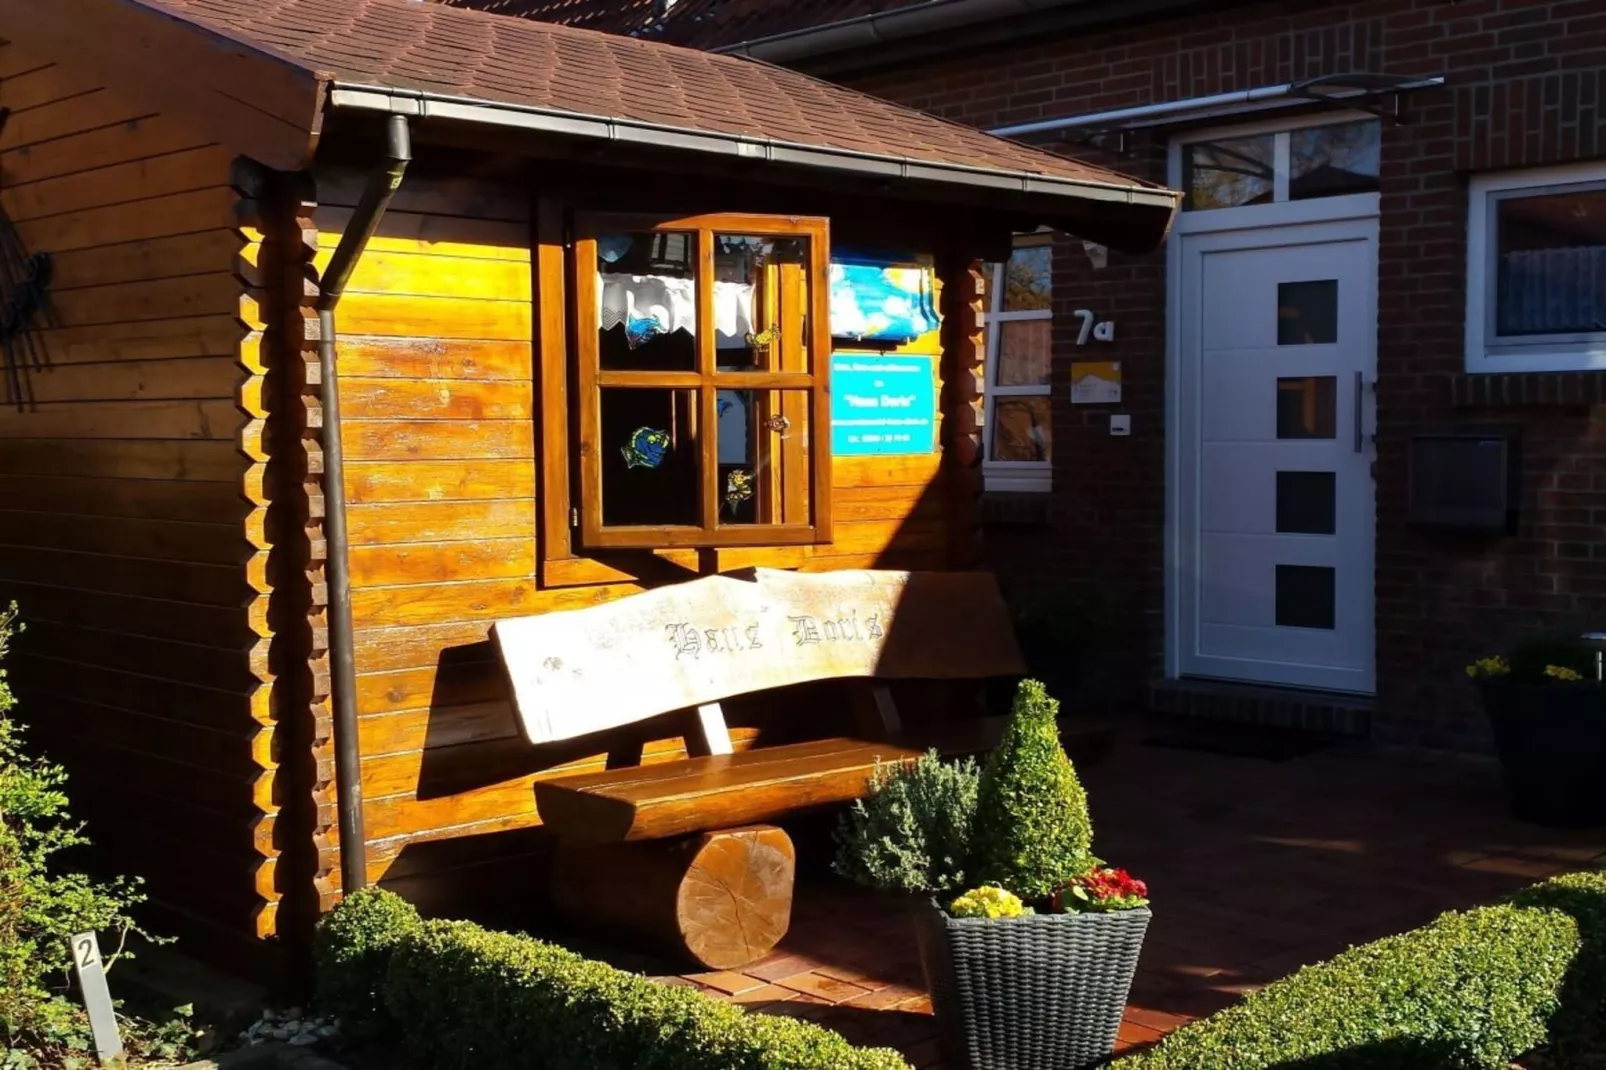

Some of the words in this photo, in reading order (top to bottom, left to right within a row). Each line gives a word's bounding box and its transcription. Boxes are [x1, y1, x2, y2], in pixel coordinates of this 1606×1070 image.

[1073, 309, 1115, 345] 7a
[787, 608, 884, 646] Doris
[78, 938, 95, 968] 2
